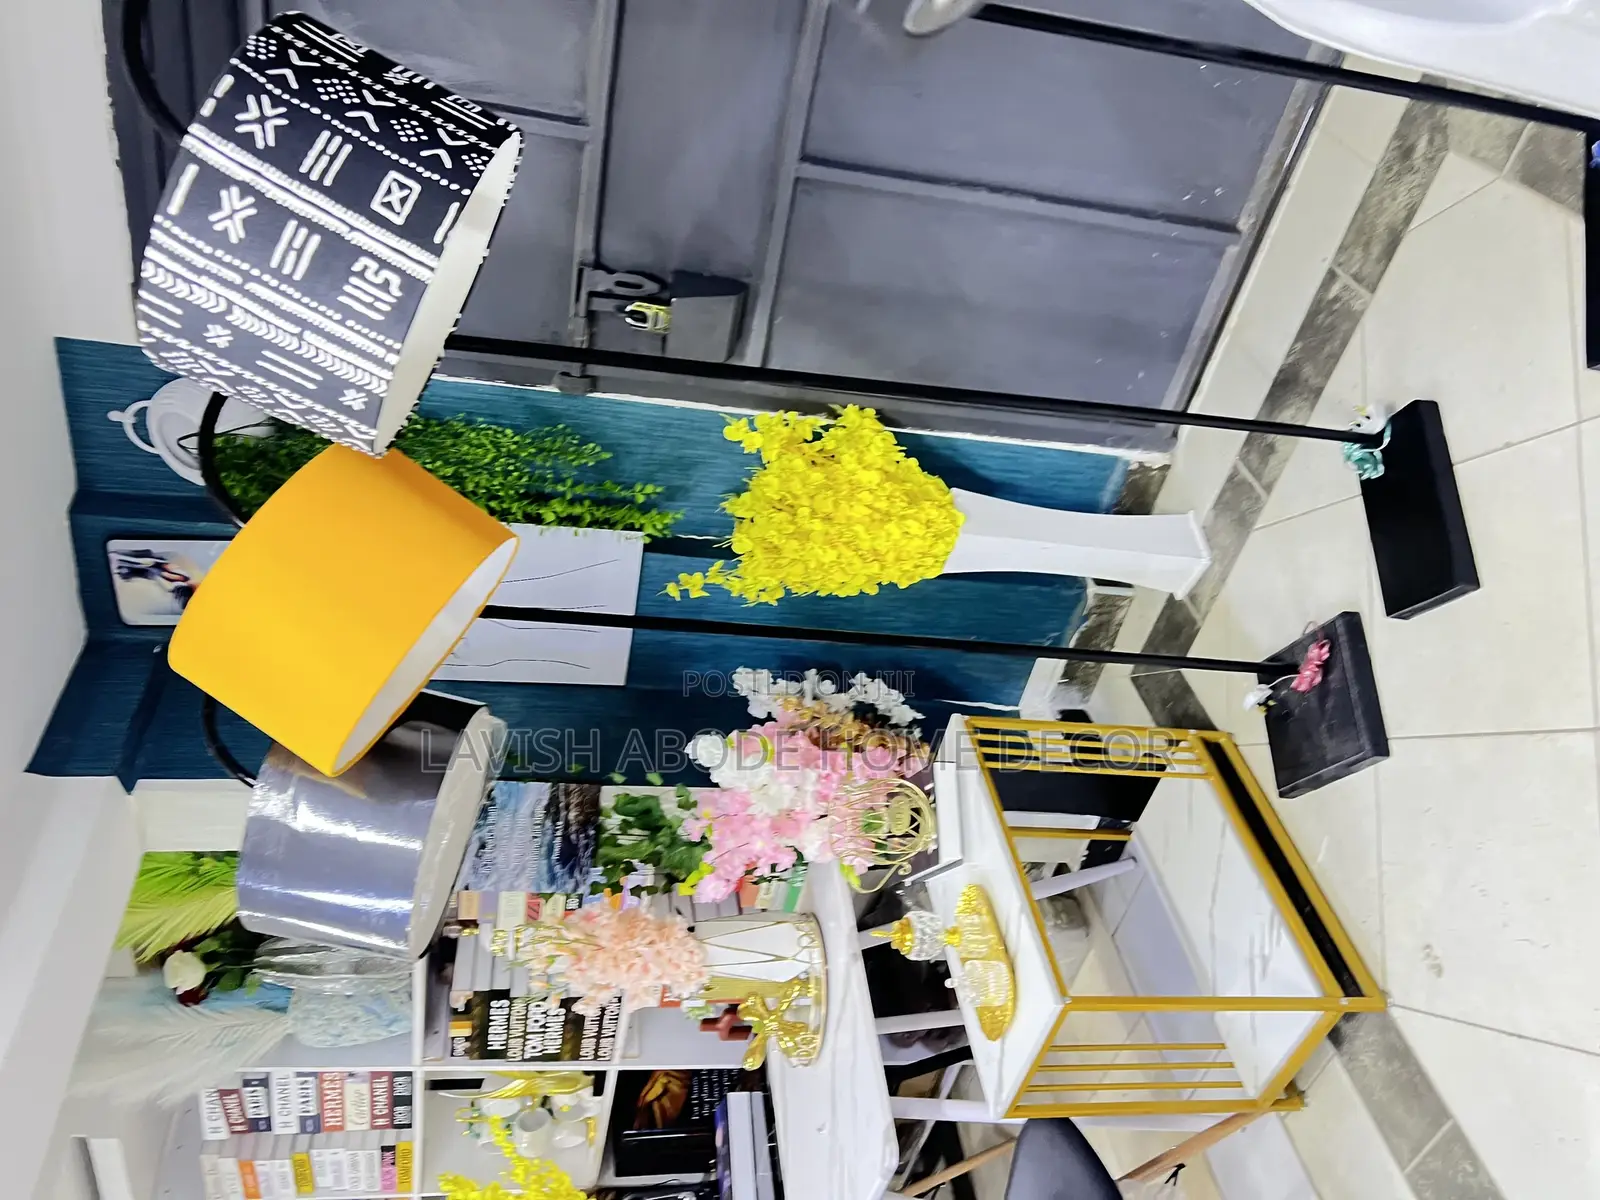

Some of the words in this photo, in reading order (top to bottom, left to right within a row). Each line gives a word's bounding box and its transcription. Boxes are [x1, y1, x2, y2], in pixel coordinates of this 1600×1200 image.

[487, 1000, 510, 1050] HERMES
[526, 1002, 551, 1032] FORD
[543, 1008, 566, 1054] HERMES
[507, 1039, 524, 1061] LOUIS
[523, 1034, 545, 1059] TOM
[579, 1038, 597, 1061] LOUIS
[597, 1038, 613, 1061] LOUIS
[221, 1093, 245, 1124] CHANEL
[372, 1076, 389, 1116] CHANEL
